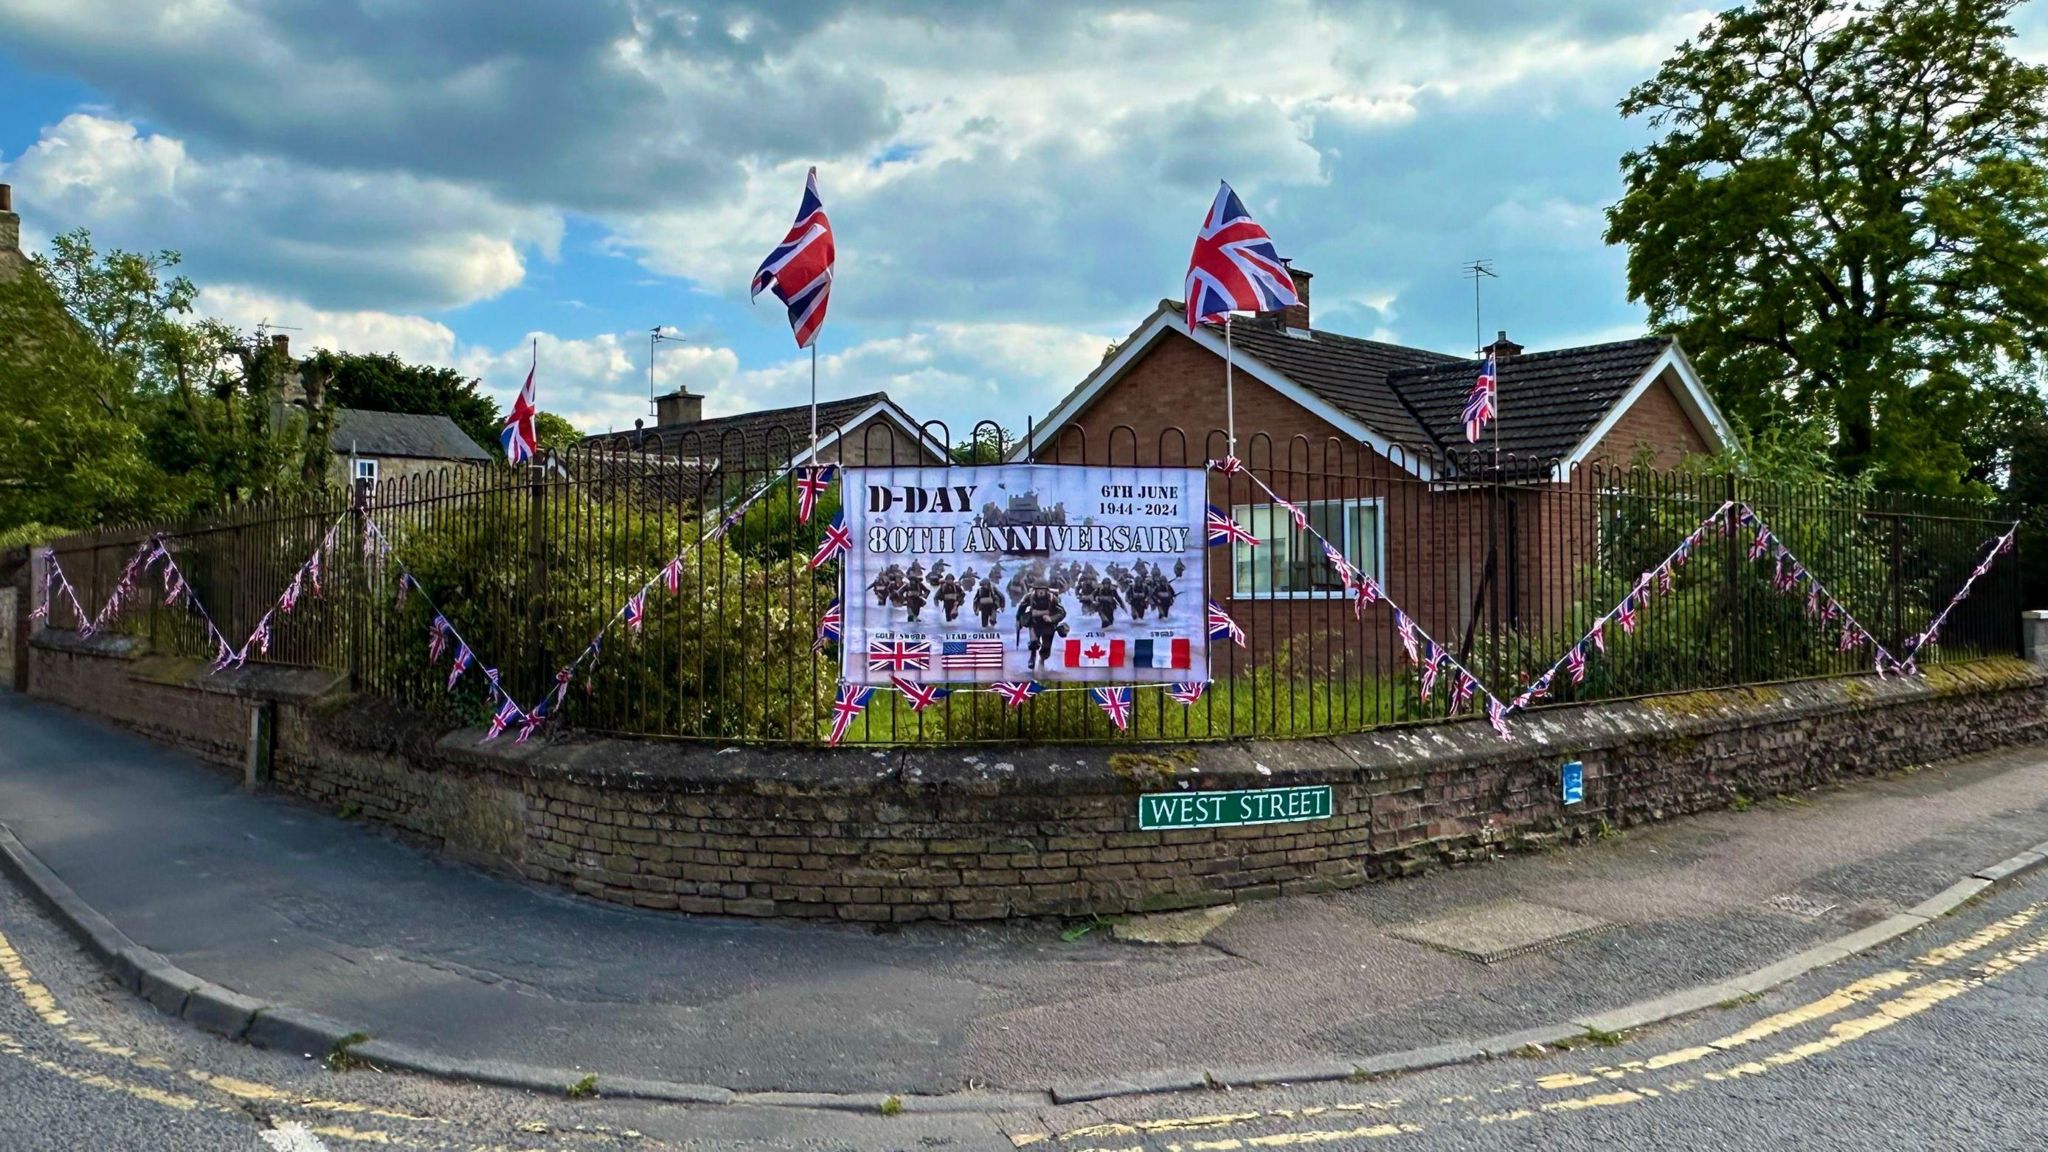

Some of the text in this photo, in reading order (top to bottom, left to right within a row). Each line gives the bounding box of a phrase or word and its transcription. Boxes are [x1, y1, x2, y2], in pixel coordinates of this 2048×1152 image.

[868, 485, 978, 513] D-DAY
[1101, 485, 1178, 499] 6TH JUNE
[1099, 502, 1133, 515] 1944
[1145, 503, 1177, 516] 2024
[868, 525, 1189, 554] 80TH ANNIVERSARY
[1151, 790, 1325, 824] WEST STREET
